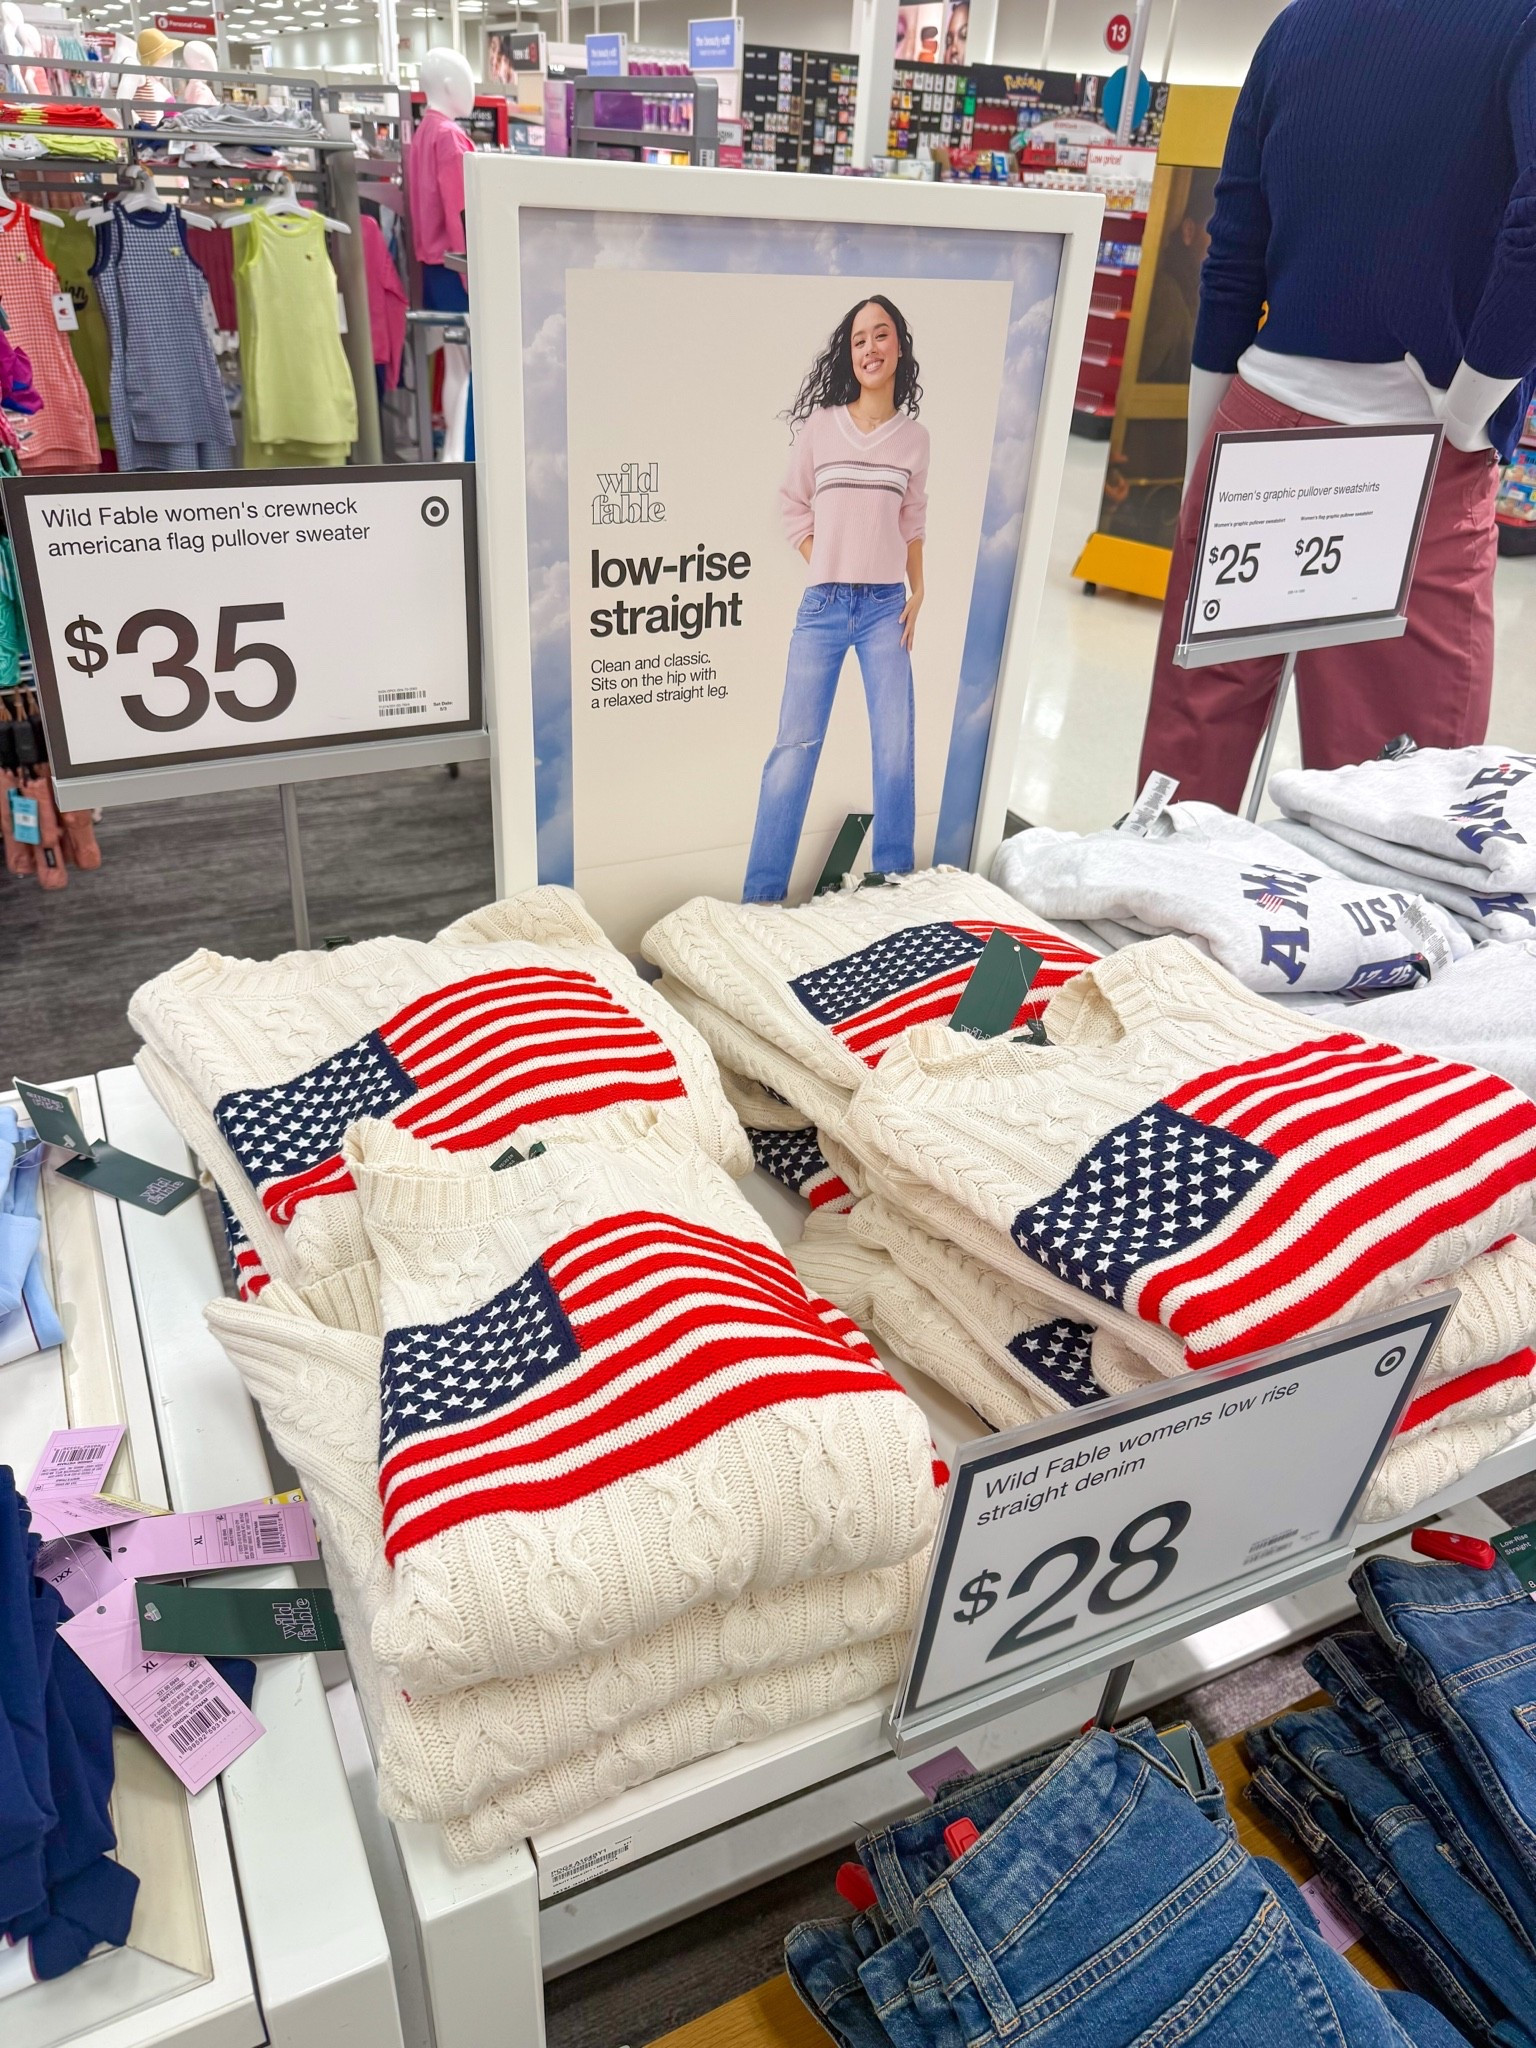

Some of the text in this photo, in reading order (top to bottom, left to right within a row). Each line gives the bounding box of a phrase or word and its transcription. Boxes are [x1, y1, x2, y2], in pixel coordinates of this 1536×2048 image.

[1111, 24, 1127, 42] 13
[596, 462, 659, 494] wild
[1219, 481, 1380, 503] Women's graphic pullover sweatshirts
[41, 497, 358, 529] Wild Fable women's crewneck
[591, 493, 667, 525] fable
[1214, 520, 1233, 529] Women's
[48, 523, 371, 557] americana flag pullover sweater
[1294, 535, 1344, 577] $25
[591, 543, 751, 588] low-rise
[1208, 542, 1261, 586] $25
[590, 592, 743, 640] straight
[64, 602, 298, 734] $35
[591, 651, 711, 673] Clean and classic.
[591, 667, 717, 691] Sits on the hip with
[591, 683, 728, 709] a relaxed straight leg.
[984, 1379, 1300, 1500] Wild Fable womens low rise
[976, 1454, 1146, 1527] straight denim
[194, 1534, 204, 1545] XL
[1500, 1533, 1529, 1548] Low-Rise
[1504, 1541, 1532, 1556] Straight
[51, 1567, 73, 1585] XXL
[953, 1500, 1192, 1664] $28
[272, 1602, 297, 1640] wild
[292, 1597, 319, 1642] fable
[142, 1660, 158, 1673] XL
[188, 1697, 209, 1714] VIETNAM
